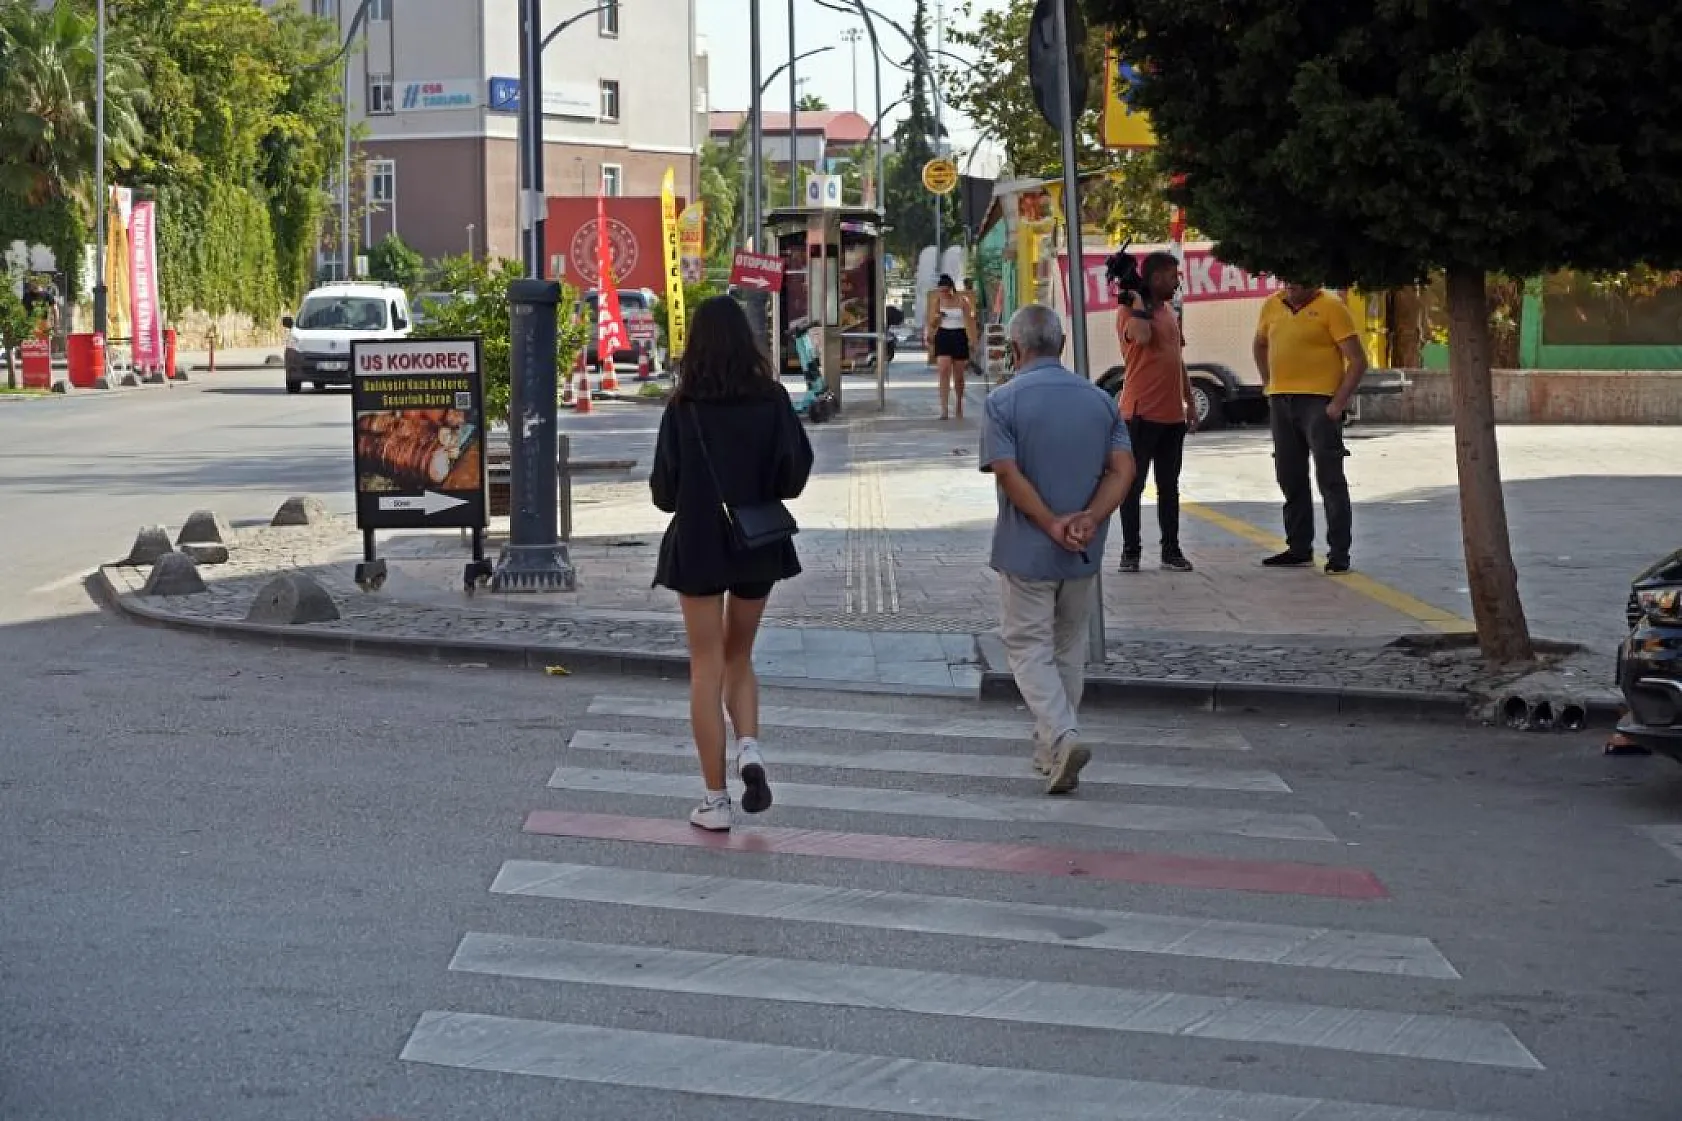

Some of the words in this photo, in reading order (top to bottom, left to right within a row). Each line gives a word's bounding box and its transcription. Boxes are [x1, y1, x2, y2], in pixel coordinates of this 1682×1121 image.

[735, 253, 782, 274] OTOPARK
[360, 353, 383, 371] US
[387, 352, 470, 372] KOKOREÇ
